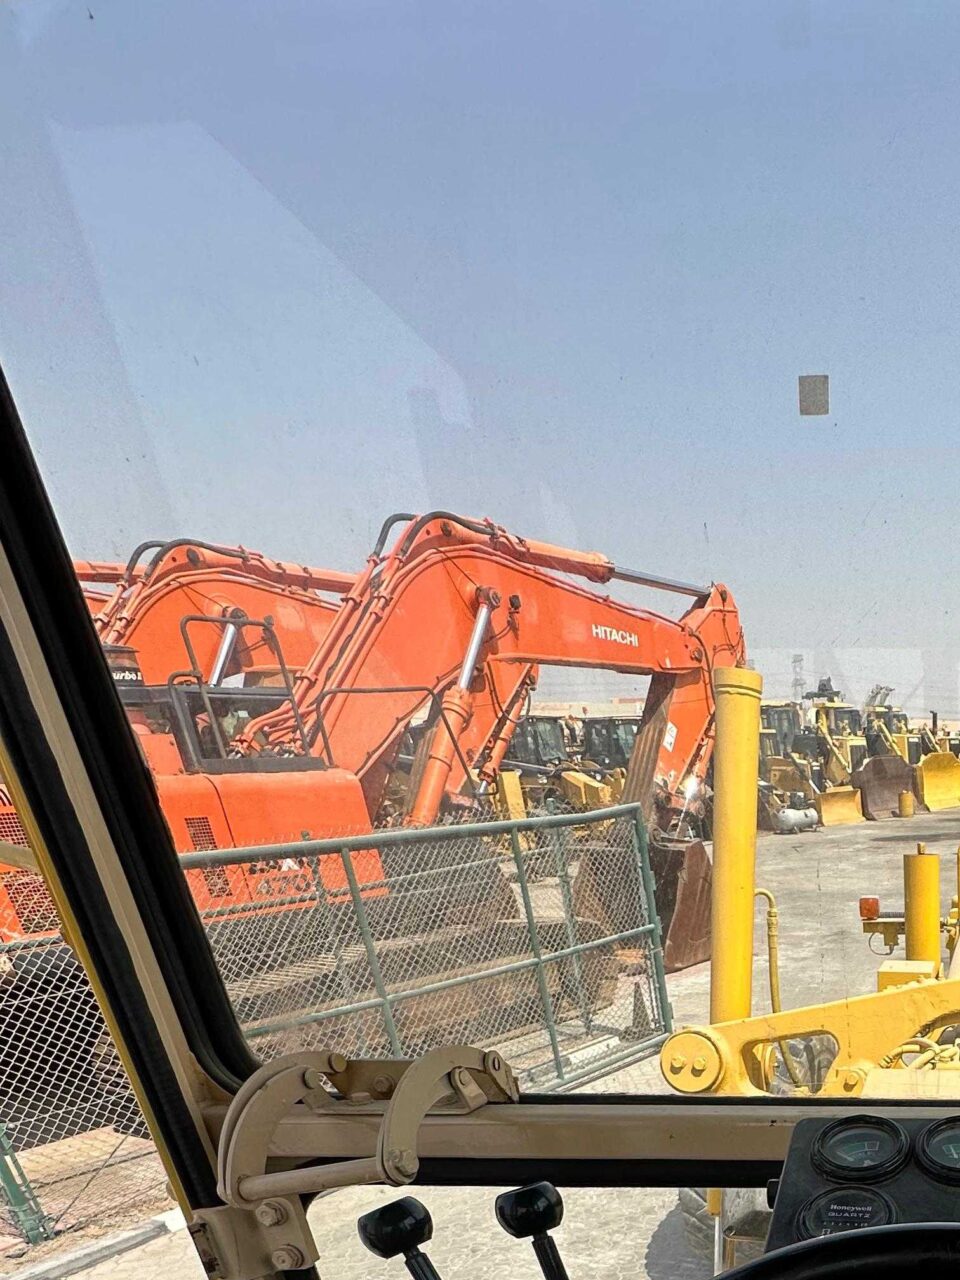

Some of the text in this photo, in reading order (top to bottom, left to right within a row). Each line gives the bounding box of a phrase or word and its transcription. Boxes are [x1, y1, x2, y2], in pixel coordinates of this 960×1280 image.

[591, 623, 639, 648] HITACHI
[112, 671, 137, 680] urbo
[830, 1204, 873, 1212] Honeywell
